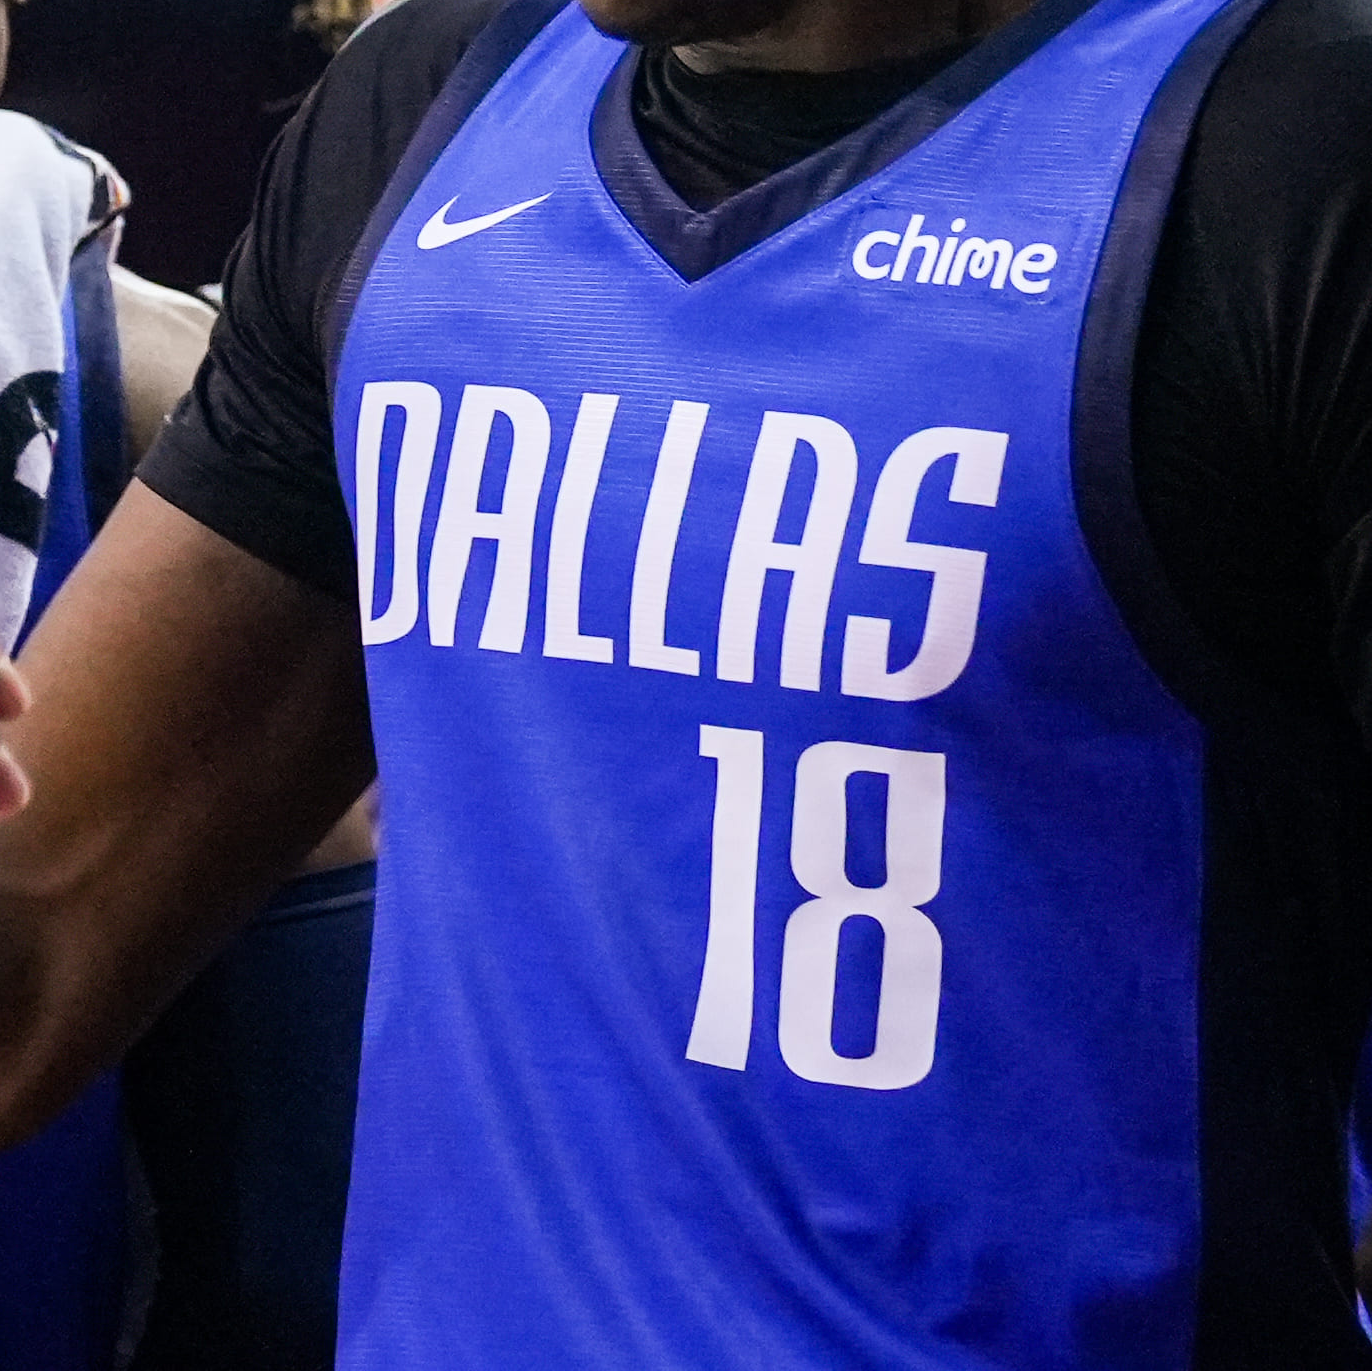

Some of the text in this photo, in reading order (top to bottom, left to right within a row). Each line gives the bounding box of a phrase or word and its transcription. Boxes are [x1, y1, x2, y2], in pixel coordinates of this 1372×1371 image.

[852, 214, 1057, 294] chime
[356, 381, 1009, 702] DALLAS
[685, 724, 947, 1090] 18
